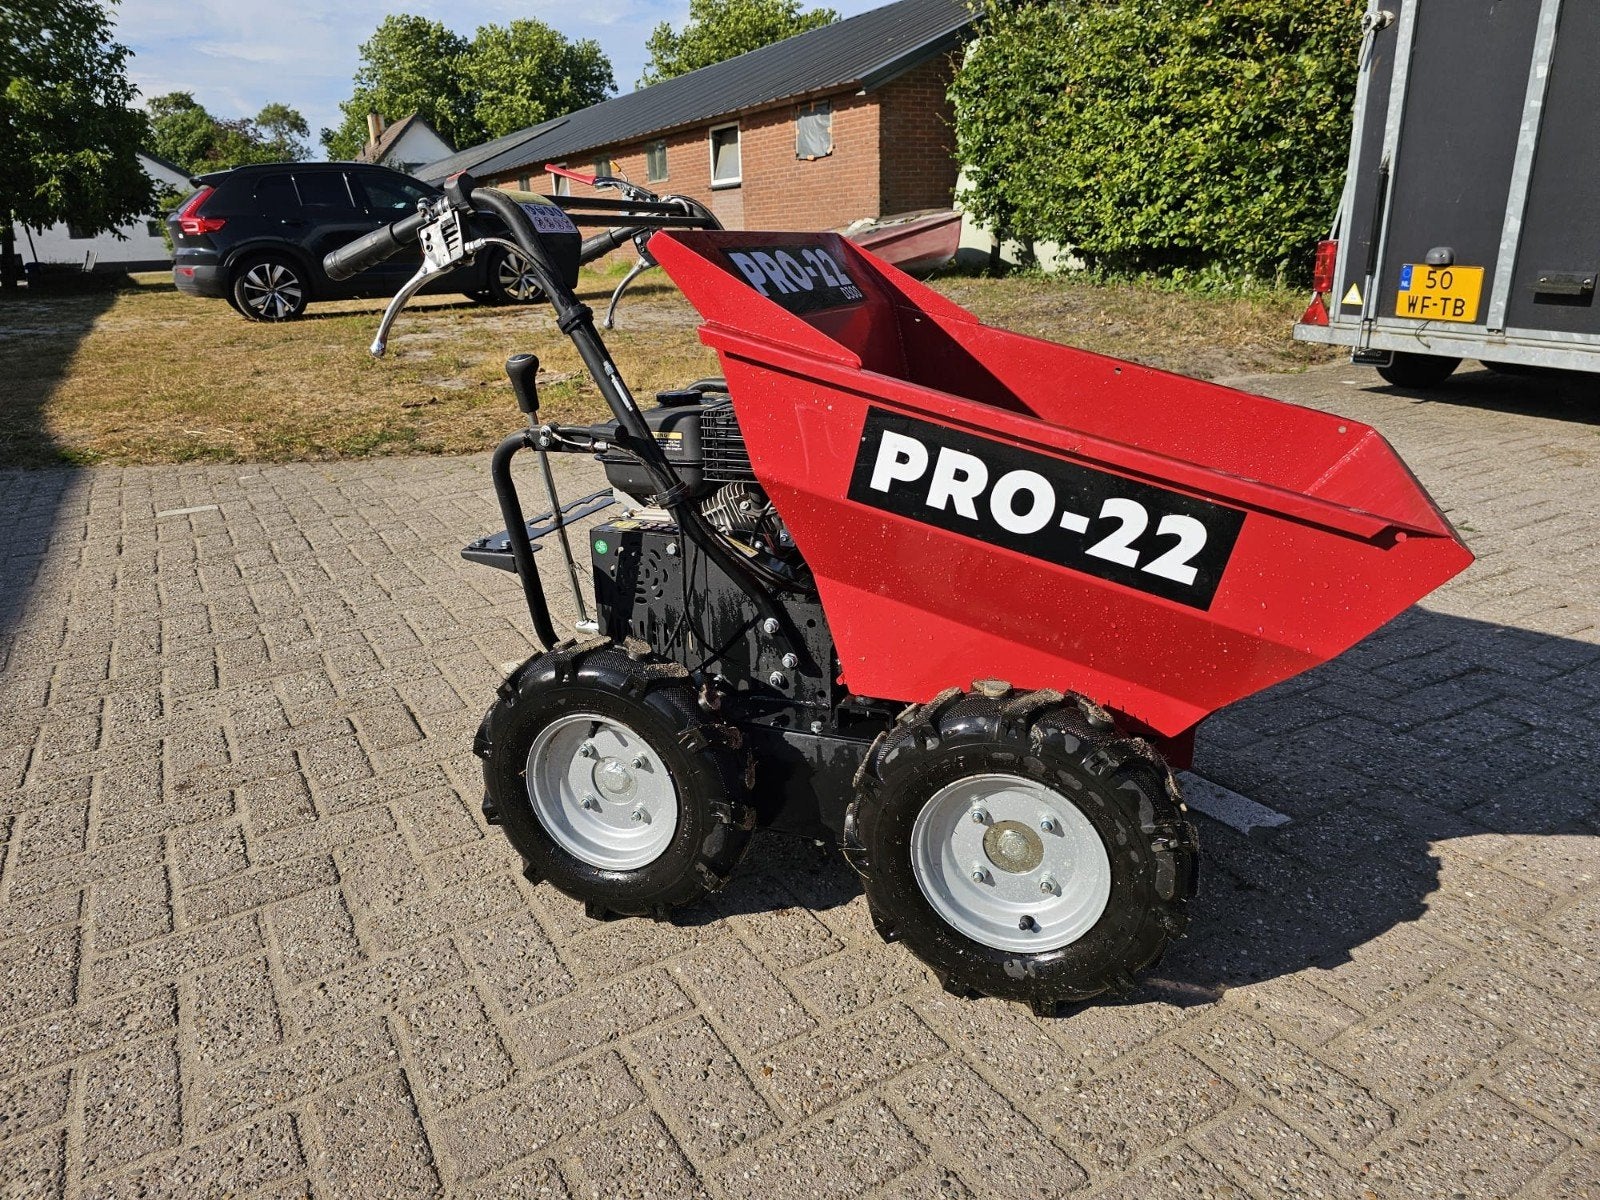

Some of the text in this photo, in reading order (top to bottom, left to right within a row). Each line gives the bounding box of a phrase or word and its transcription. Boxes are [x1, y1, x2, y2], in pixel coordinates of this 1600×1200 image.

[728, 249, 852, 296] PRO-22
[1425, 270, 1453, 290] 50
[1407, 295, 1466, 317] WF-TB
[869, 429, 1208, 586] PRO-22
